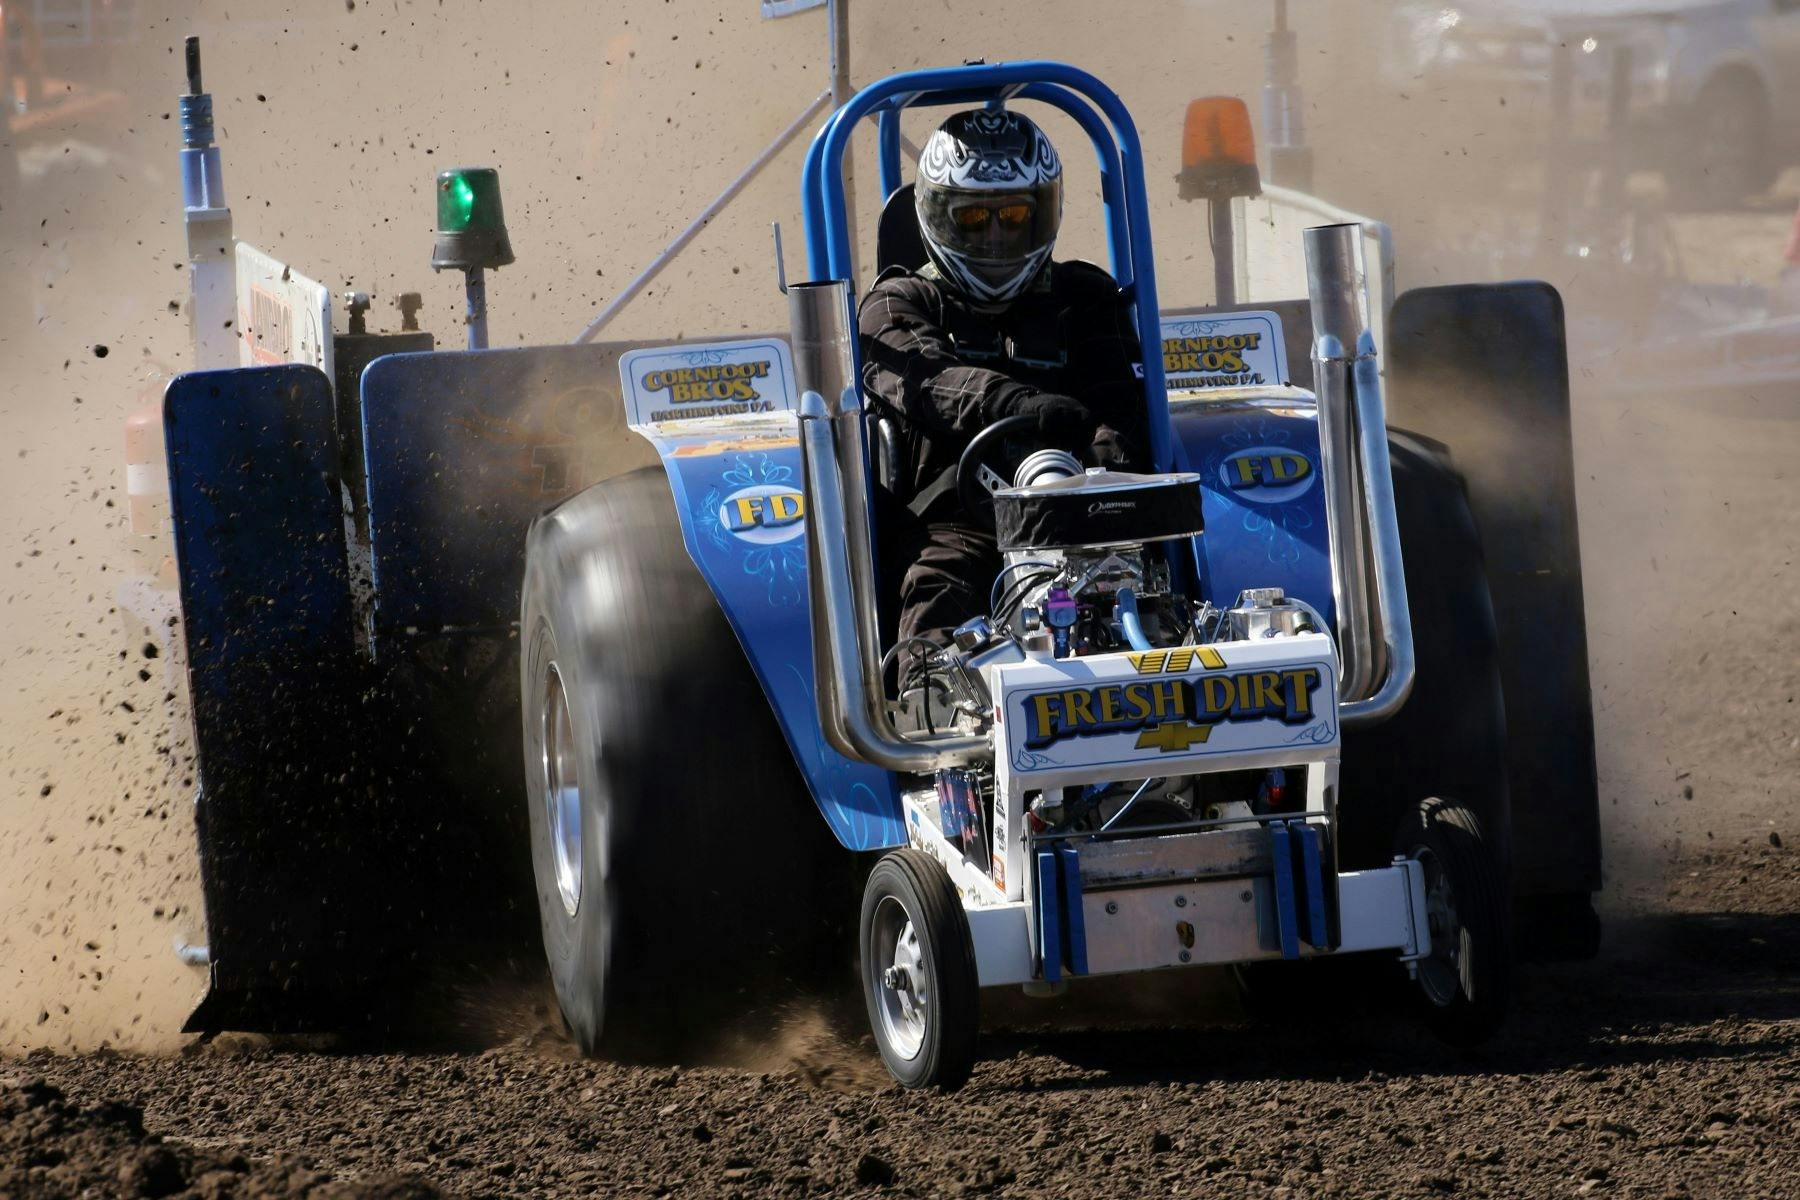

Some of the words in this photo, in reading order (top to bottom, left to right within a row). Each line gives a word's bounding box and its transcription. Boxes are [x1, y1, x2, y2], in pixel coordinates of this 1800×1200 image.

[642, 360, 770, 392] CORNFOOT
[1164, 350, 1250, 373] BROS.
[669, 379, 760, 404] BROS.
[1228, 456, 1313, 490] FD
[728, 492, 804, 532] FD
[1022, 680, 1191, 751] FRESH
[1195, 668, 1321, 727] DIRT
